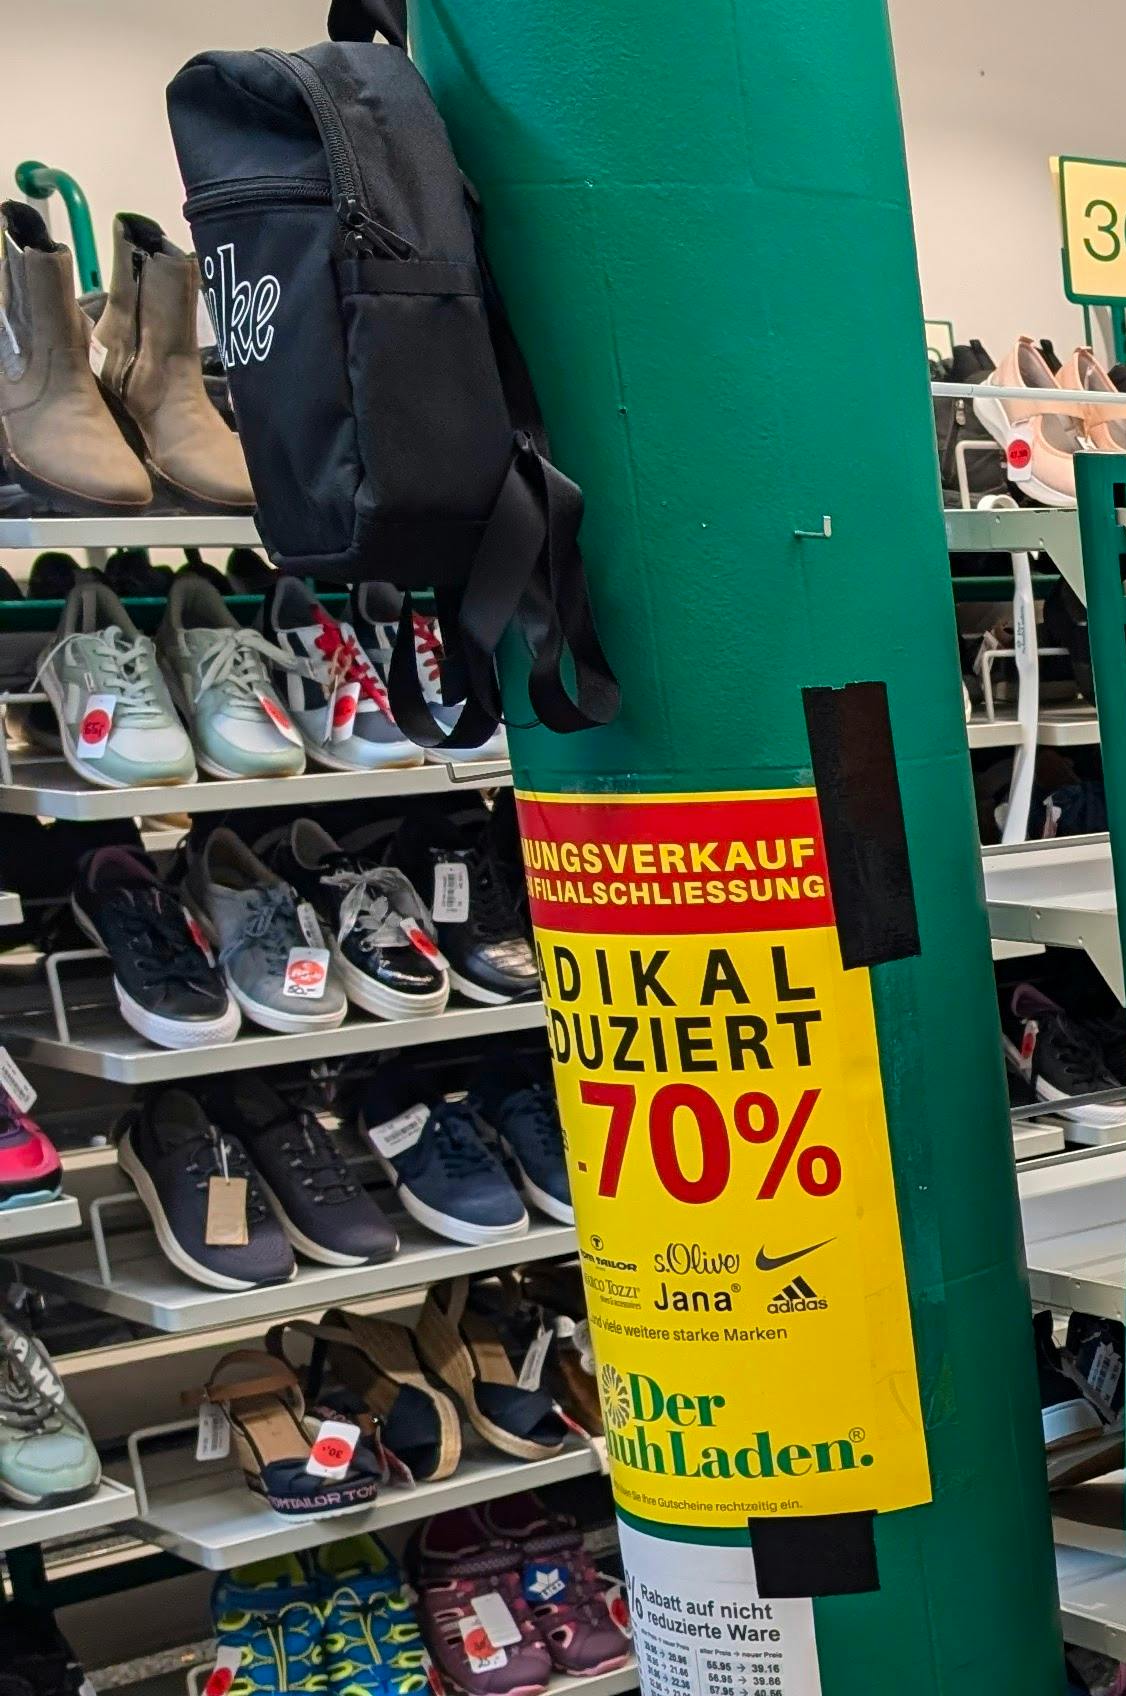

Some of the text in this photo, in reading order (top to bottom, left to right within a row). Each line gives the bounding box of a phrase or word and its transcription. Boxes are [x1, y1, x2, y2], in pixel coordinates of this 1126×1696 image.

[767, 1298, 828, 1315] adidas
[624, 1324, 670, 1341] weitere
[673, 1327, 720, 1342] starke
[723, 1325, 788, 1342] Marken
[625, 1371, 726, 1428] Der
[657, 1497, 713, 1512] Gutscheine
[715, 1500, 778, 1513] rechtzeitig
[780, 1498, 803, 1510] ein.
[640, 1583, 774, 1621] Rabatt auf nicht
[647, 1609, 781, 1643] reduzierte Ware
